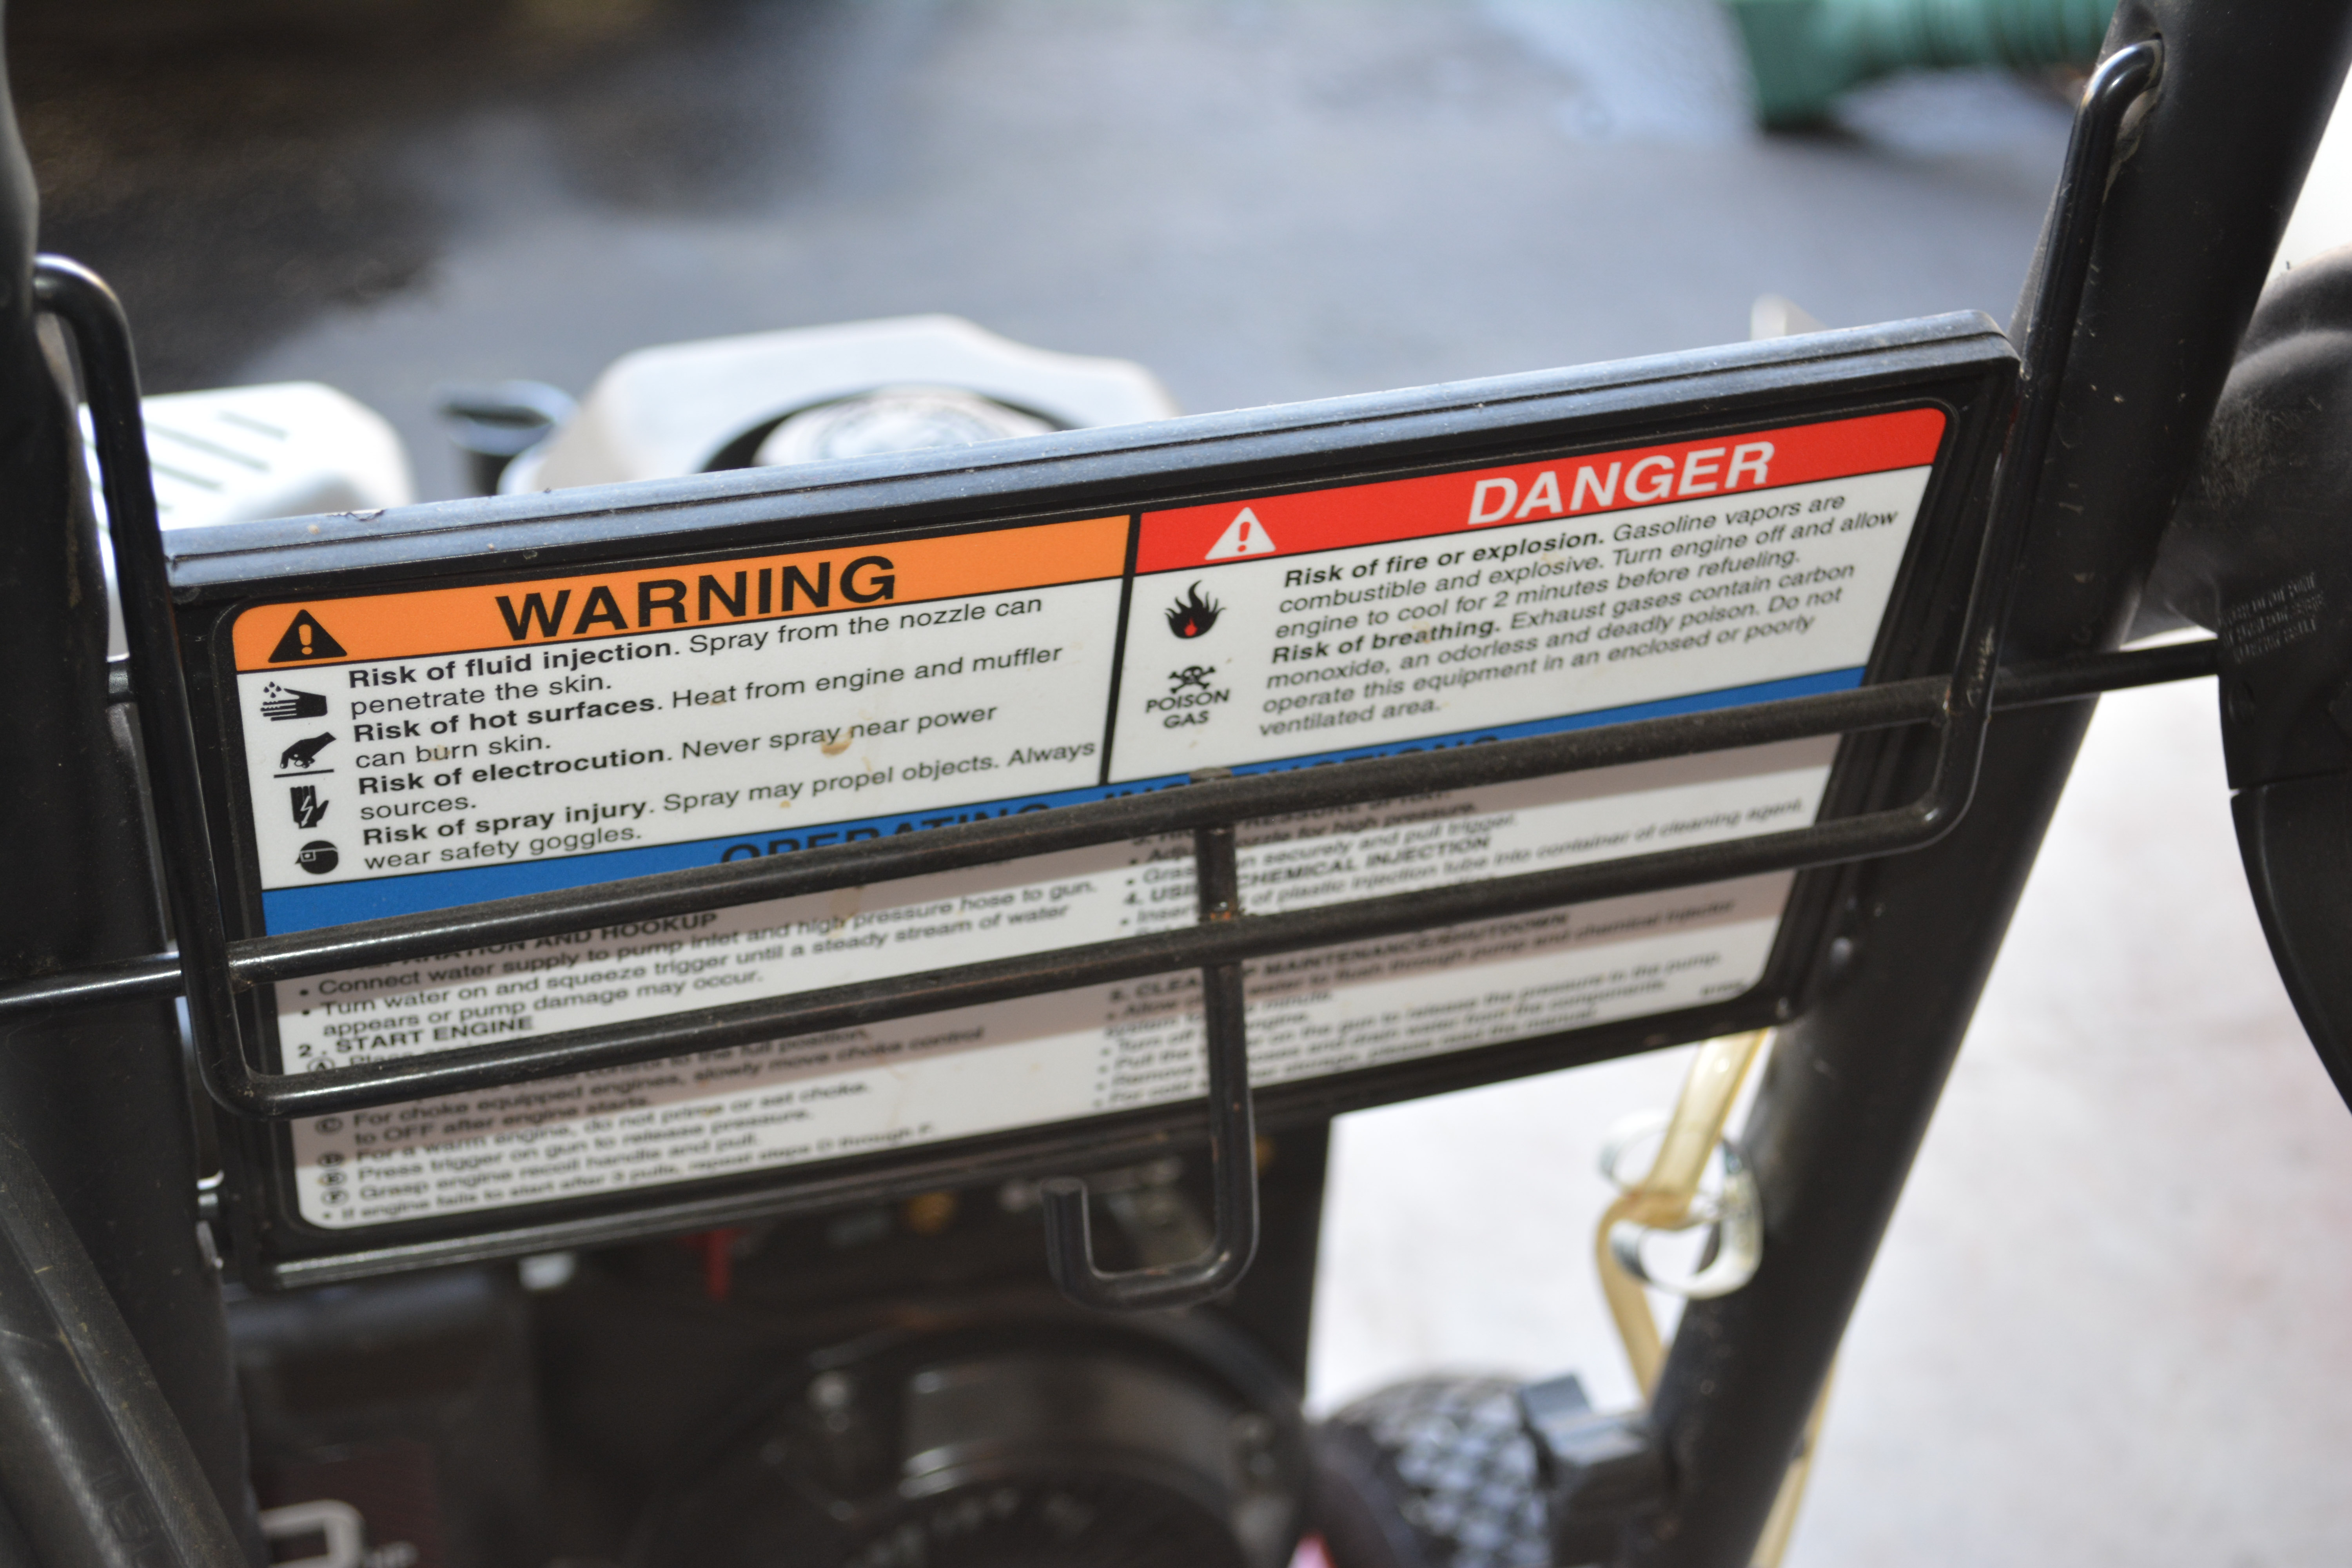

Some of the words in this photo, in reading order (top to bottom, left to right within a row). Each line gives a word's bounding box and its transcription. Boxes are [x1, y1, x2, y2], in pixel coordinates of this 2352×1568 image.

[1468, 441, 1775, 525] DANGER
[1277, 577, 1427, 615] combustible
[1434, 567, 1483, 593] and
[1487, 554, 1605, 586] explosive.
[1611, 545, 1663, 568] Turn
[1669, 533, 1748, 559] engine
[1753, 523, 1787, 546] off
[1789, 515, 1837, 540] and
[1839, 510, 1899, 532] allow
[1282, 563, 1345, 589] Risk
[1350, 557, 1381, 579] of
[1385, 554, 1428, 575] fire
[1436, 549, 1466, 568] or
[1471, 531, 1606, 564] explosion.
[1612, 514, 1717, 543] Gasoline
[1724, 501, 1802, 527] vapors
[1807, 495, 1845, 514] are
[495, 556, 896, 641] WARNING
[1265, 657, 1392, 690] monoxide,
[1399, 652, 1431, 670] an
[1436, 637, 1538, 665] odorless
[1545, 624, 1592, 648] and
[1595, 615, 1676, 641] deadly
[1677, 602, 1761, 633] poison.
[1766, 593, 1801, 615] Do
[1804, 585, 1844, 608] not
[1270, 639, 1331, 666] Risk
[1336, 633, 1366, 655] of
[1370, 619, 1502, 651] breathing.
[1509, 600, 1607, 631] Exhaust
[1611, 592, 1682, 620] gases
[1687, 575, 1772, 604] contain
[1777, 563, 1856, 589] carbon
[1274, 613, 1359, 640] engine
[1365, 608, 1391, 627] to
[1395, 597, 1450, 623] cool
[1454, 594, 1489, 615] for
[1491, 589, 1510, 609] 2
[1514, 578, 1609, 606] minutes
[1615, 566, 1690, 591] before
[1695, 549, 1801, 579] refueling.
[348, 664, 417, 689] Risk
[425, 659, 456, 682] of
[464, 652, 532, 678] fluid
[543, 641, 681, 672] injection.
[688, 630, 769, 657] Spray
[777, 622, 838, 644] from
[848, 615, 890, 635] the
[899, 602, 986, 630] nozzle
[994, 598, 1042, 617] can
[1261, 686, 1355, 717] operate
[1362, 677, 1405, 699] this
[1412, 657, 1539, 693] equipment
[1543, 653, 1565, 671] in
[1570, 650, 1601, 668] an
[1607, 628, 1713, 661] enclosed
[1715, 626, 1742, 645] or
[1742, 612, 1816, 645] poorly
[350, 687, 485, 721] penetrate
[494, 681, 539, 701] the
[548, 673, 612, 696] skin.
[352, 719, 421, 743] Risk
[429, 713, 460, 735] of
[468, 709, 518, 731] hot
[526, 697, 663, 725] surfaces.
[671, 684, 737, 709] Heat
[744, 679, 806, 701] from
[815, 667, 905, 693] engine
[913, 655, 964, 679] and
[971, 646, 1063, 672] muffler
[1144, 688, 1231, 714] POISON
[1162, 709, 1209, 729] GAS
[1257, 702, 1377, 738] ventilated
[1381, 699, 1443, 719] area.
[354, 750, 406, 769] can
[414, 742, 479, 763] burn
[488, 733, 551, 755] skin.
[358, 771, 425, 796] Risk
[432, 766, 463, 788] of
[471, 748, 673, 783] electrocution.
[681, 736, 761, 760] Never
[769, 726, 841, 751] spray
[848, 717, 910, 739] near
[916, 706, 998, 735] power
[362, 822, 428, 847] Risk
[436, 817, 466, 838] of
[475, 811, 556, 837] spray
[564, 800, 655, 826] injury.
[662, 789, 740, 814] Spray
[748, 781, 804, 802] may
[811, 765, 894, 798] propel
[901, 755, 1000, 782] objects.
[1006, 742, 1094, 767] Always
[359, 796, 477, 821] sources.
[363, 849, 432, 871] wear
[440, 838, 521, 862] safety
[528, 826, 642, 857] goggles.
[316, 968, 422, 997] Connect
[425, 961, 497, 984] water
[501, 950, 582, 973] supply
[585, 947, 611, 962] to
[615, 937, 685, 965] pump
[689, 928, 741, 950] inlet
[746, 920, 792, 942] and
[795, 913, 847, 937] high
[849, 902, 953, 933] pressure
[957, 893, 1015, 915] hose
[1020, 887, 1044, 902] to
[1049, 880, 1098, 902] gun.
[318, 998, 378, 1018] Turn
[381, 988, 452, 1011] water
[456, 984, 490, 1002] on
[494, 974, 541, 996] and
[546, 966, 647, 992] squeeze
[652, 953, 731, 977] trigger
[734, 944, 784, 966] until
[790, 944, 806, 957] a
[812, 931, 890, 953] steady
[895, 920, 973, 941] stream
[978, 911, 1003, 929] of
[1005, 904, 1069, 925] water
[600, 913, 718, 942] HOOKUP
[321, 1014, 421, 1042] appears
[425, 1008, 454, 1025] or
[457, 1000, 527, 1027] pump
[531, 988, 629, 1012] damage
[635, 978, 688, 998] may
[691, 969, 764, 991] occur.
[336, 1029, 423, 1053] START
[434, 1016, 534, 1042] ENGINE
